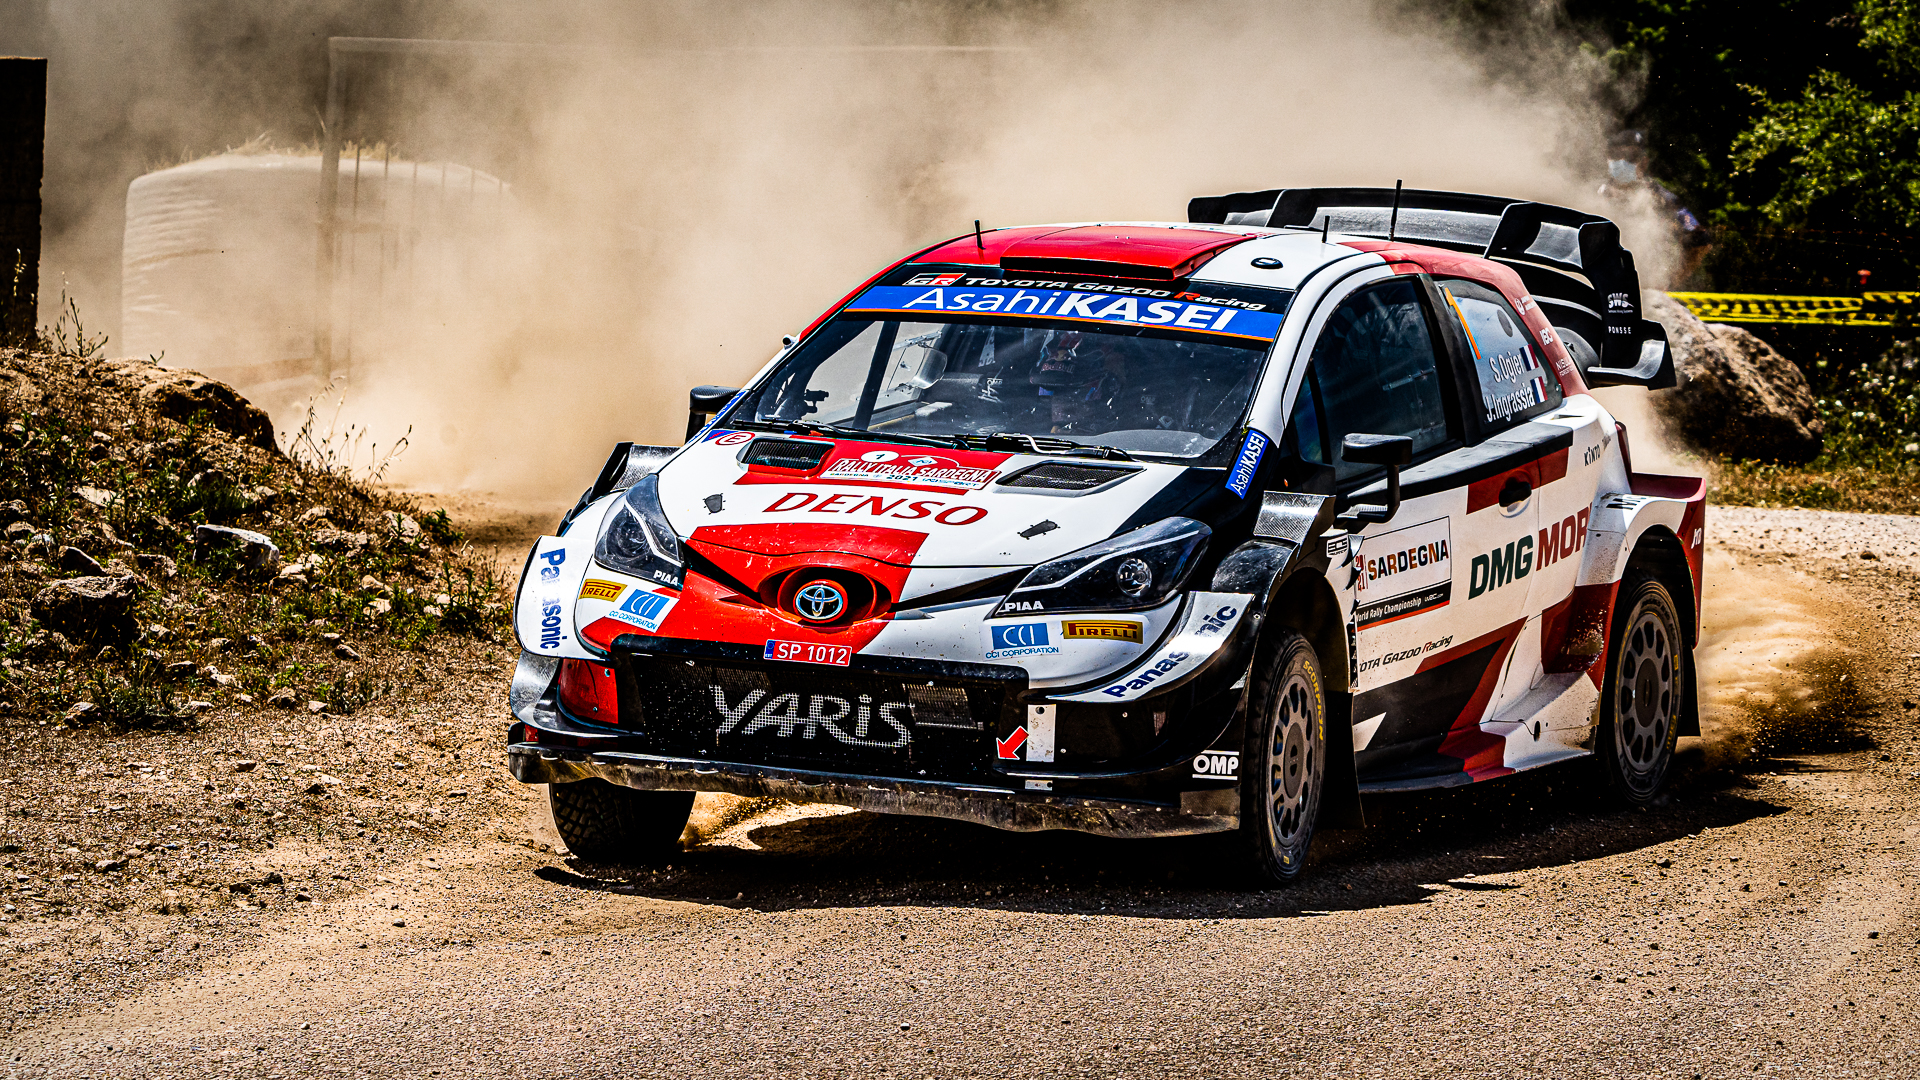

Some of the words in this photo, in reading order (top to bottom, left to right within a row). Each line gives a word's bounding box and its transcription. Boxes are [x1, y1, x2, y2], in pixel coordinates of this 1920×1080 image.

[901, 288, 1239, 330] AsahiKASEI
[909, 276, 962, 286] GR
[964, 277, 1068, 289] TOYOTA
[1072, 281, 1171, 297] GAZOO
[1173, 290, 1267, 311] Racing
[1607, 292, 1630, 309] SWS
[1445, 287, 1482, 360] 1
[1489, 351, 1525, 384] S.Ogier
[1485, 383, 1536, 422] J.Ingrassia
[833, 460, 875, 473] RALLY
[872, 462, 918, 476] ITALIA
[917, 466, 992, 482] SARDEGNA
[1229, 432, 1266, 496] AsahiKASEI
[761, 492, 989, 526] DENSO
[1367, 539, 1450, 581] SARDEGNA
[1468, 534, 1534, 600] DMG
[1536, 502, 1593, 572] MOR
[580, 581, 623, 599] PIRELLI
[653, 569, 679, 586] PIAA
[540, 547, 568, 650] Pasonic
[1003, 600, 1045, 612] PIAA
[1369, 607, 1384, 619] Rally
[1383, 597, 1422, 615] Championship
[618, 612, 658, 630] CORPORATION
[1067, 622, 1139, 640] PIRELLI
[777, 642, 802, 660] SP
[808, 645, 848, 664] 1012
[985, 651, 1000, 660] CCI
[1001, 646, 1060, 658] CORPORATION
[1101, 605, 1238, 699] Panasnic
[1382, 646, 1422, 666] GAZOO
[1421, 634, 1454, 654] Racing
[1192, 753, 1240, 775] OMP
